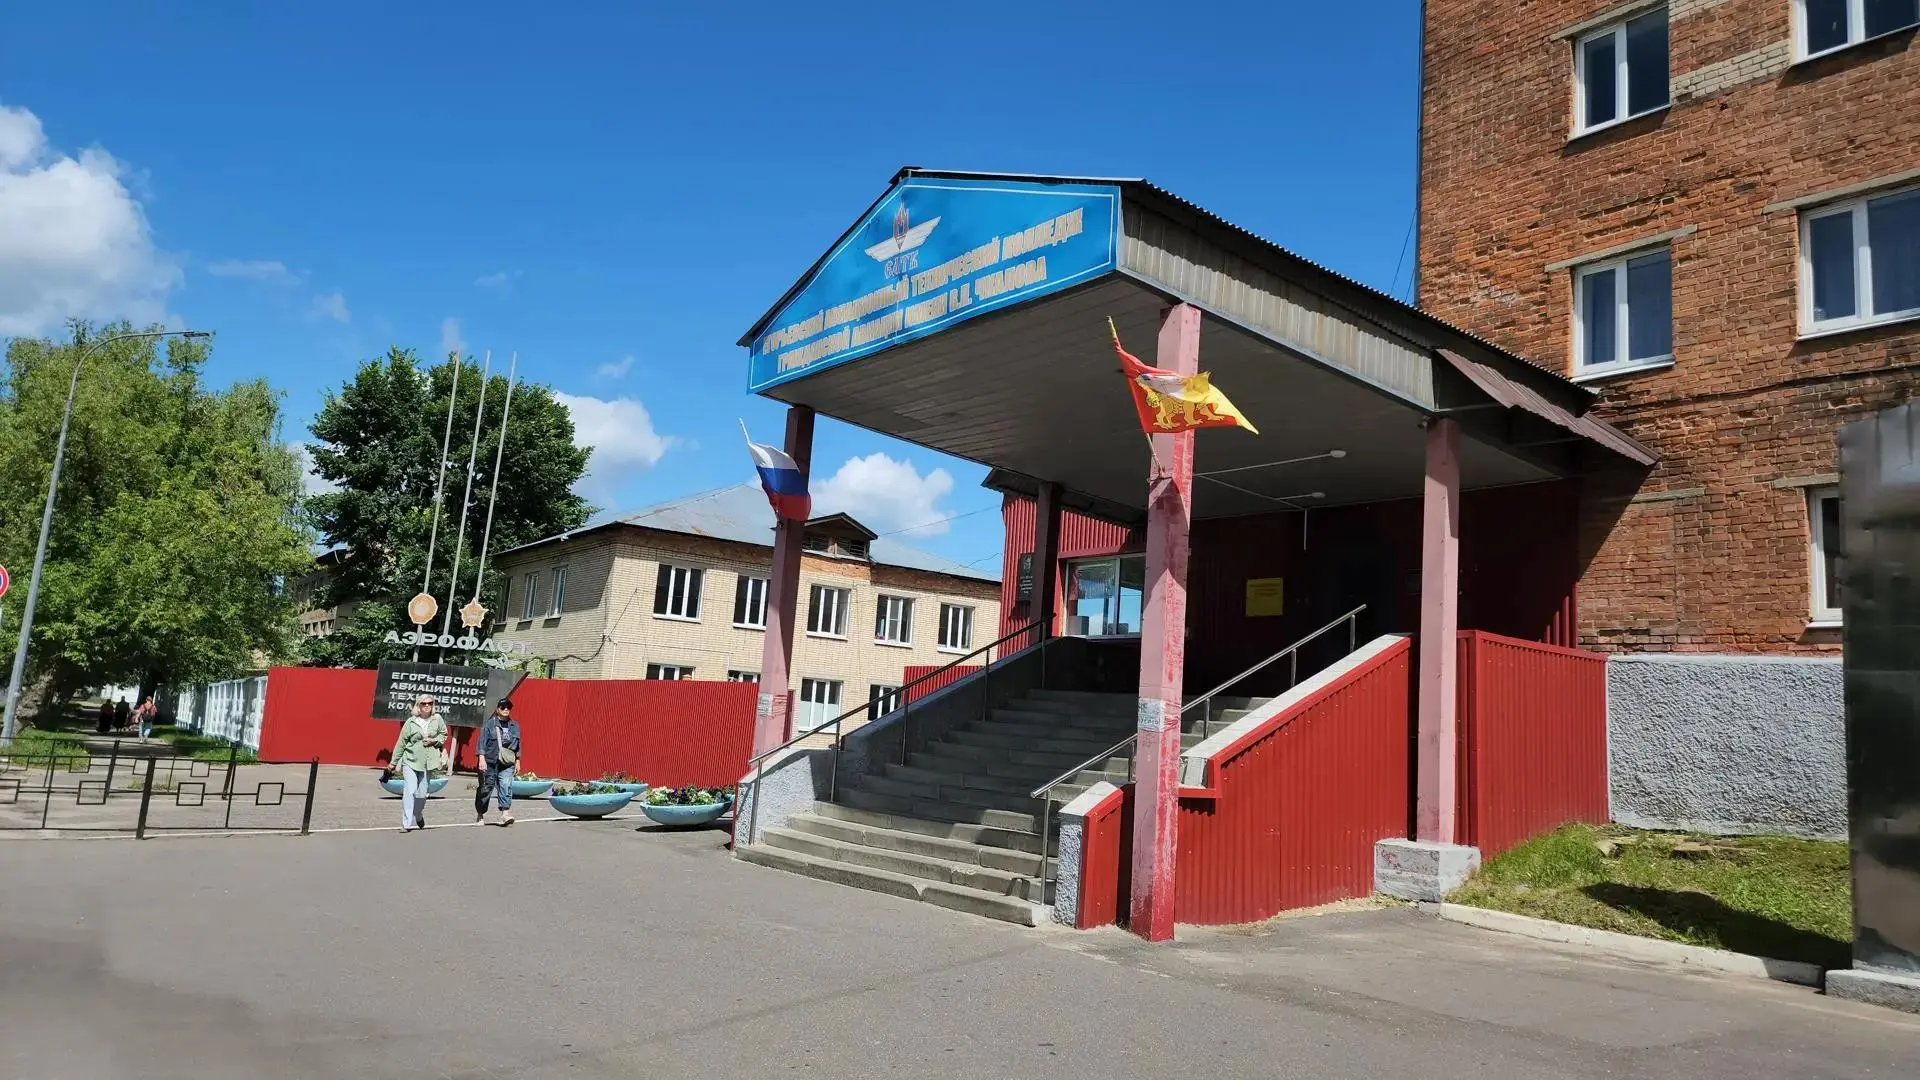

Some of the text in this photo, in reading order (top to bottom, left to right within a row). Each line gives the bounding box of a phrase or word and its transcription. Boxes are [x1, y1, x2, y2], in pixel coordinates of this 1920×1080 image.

[911, 236, 1000, 297] ТЕХНИЧЕСКИЙ
[1002, 207, 1084, 261] КОЛЛЕДЖ
[904, 292, 948, 328] ИМЕНИ
[974, 256, 1047, 301] ЧКАЛОВА
[383, 631, 532, 655] АЭРОФЛОТ
[390, 682, 485, 696] АВИАЦИОННО-
